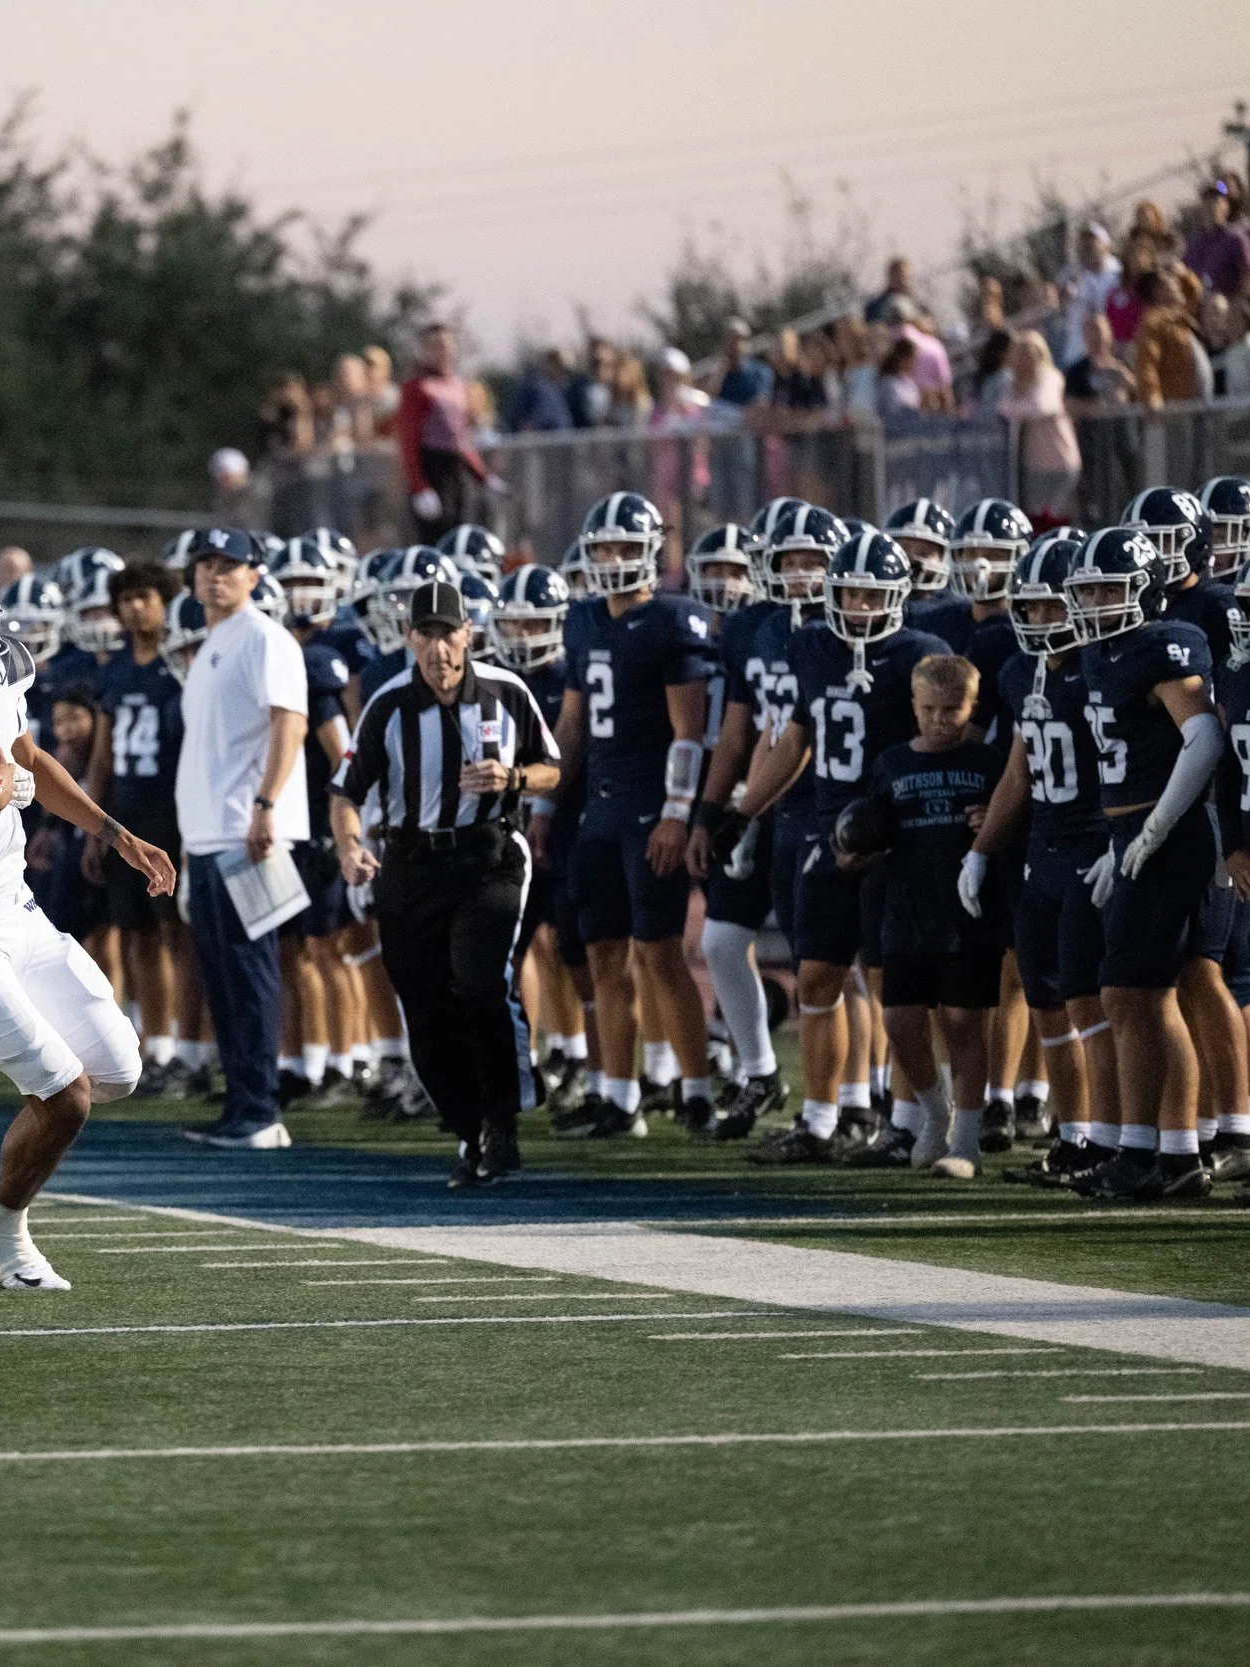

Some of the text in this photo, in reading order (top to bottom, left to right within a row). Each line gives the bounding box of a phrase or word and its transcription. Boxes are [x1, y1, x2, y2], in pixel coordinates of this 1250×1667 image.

[1167, 643, 1190, 667] SV
[586, 662, 614, 738] 2
[112, 705, 159, 777] 14
[810, 697, 866, 782] 13
[947, 770, 986, 791] VALLEY
